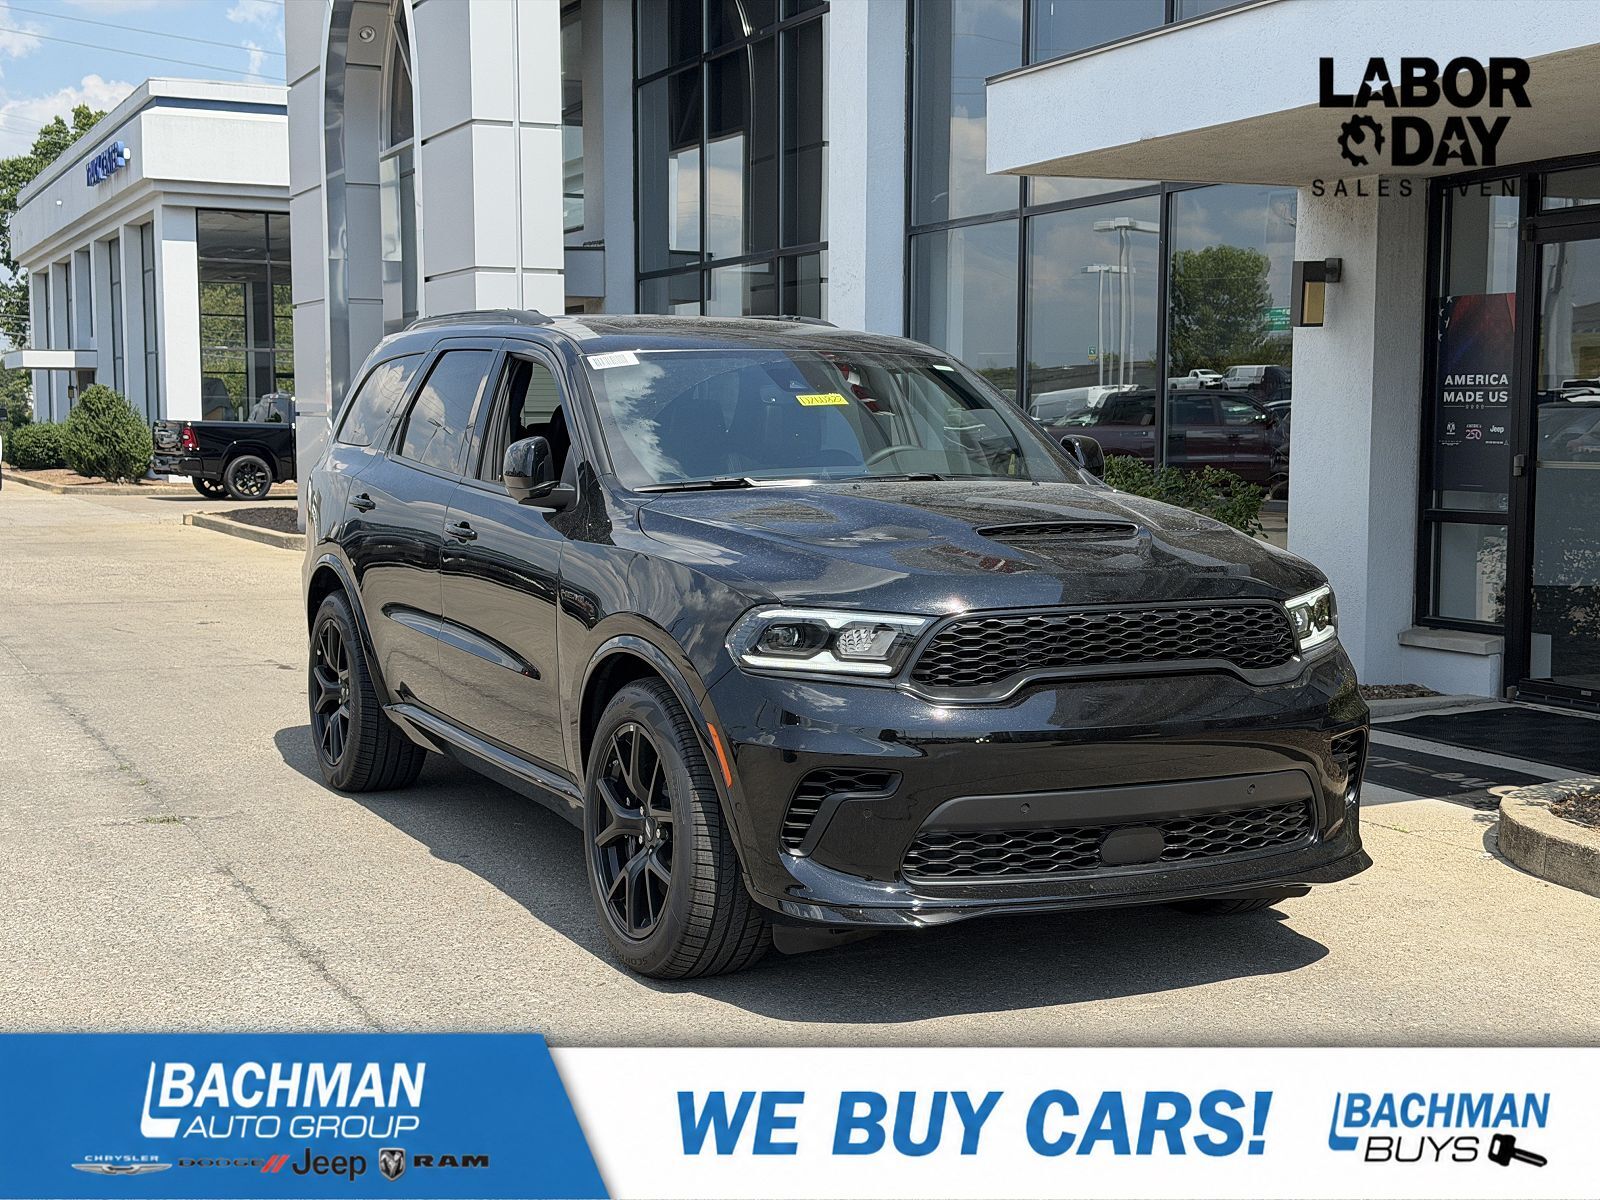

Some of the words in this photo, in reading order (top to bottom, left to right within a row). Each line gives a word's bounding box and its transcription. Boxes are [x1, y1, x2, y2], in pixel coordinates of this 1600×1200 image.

[1444, 374, 1509, 385] AMERICA
[1443, 391, 1484, 403] MADE
[1488, 391, 1508, 403] US
[1489, 424, 1505, 434] Jeep
